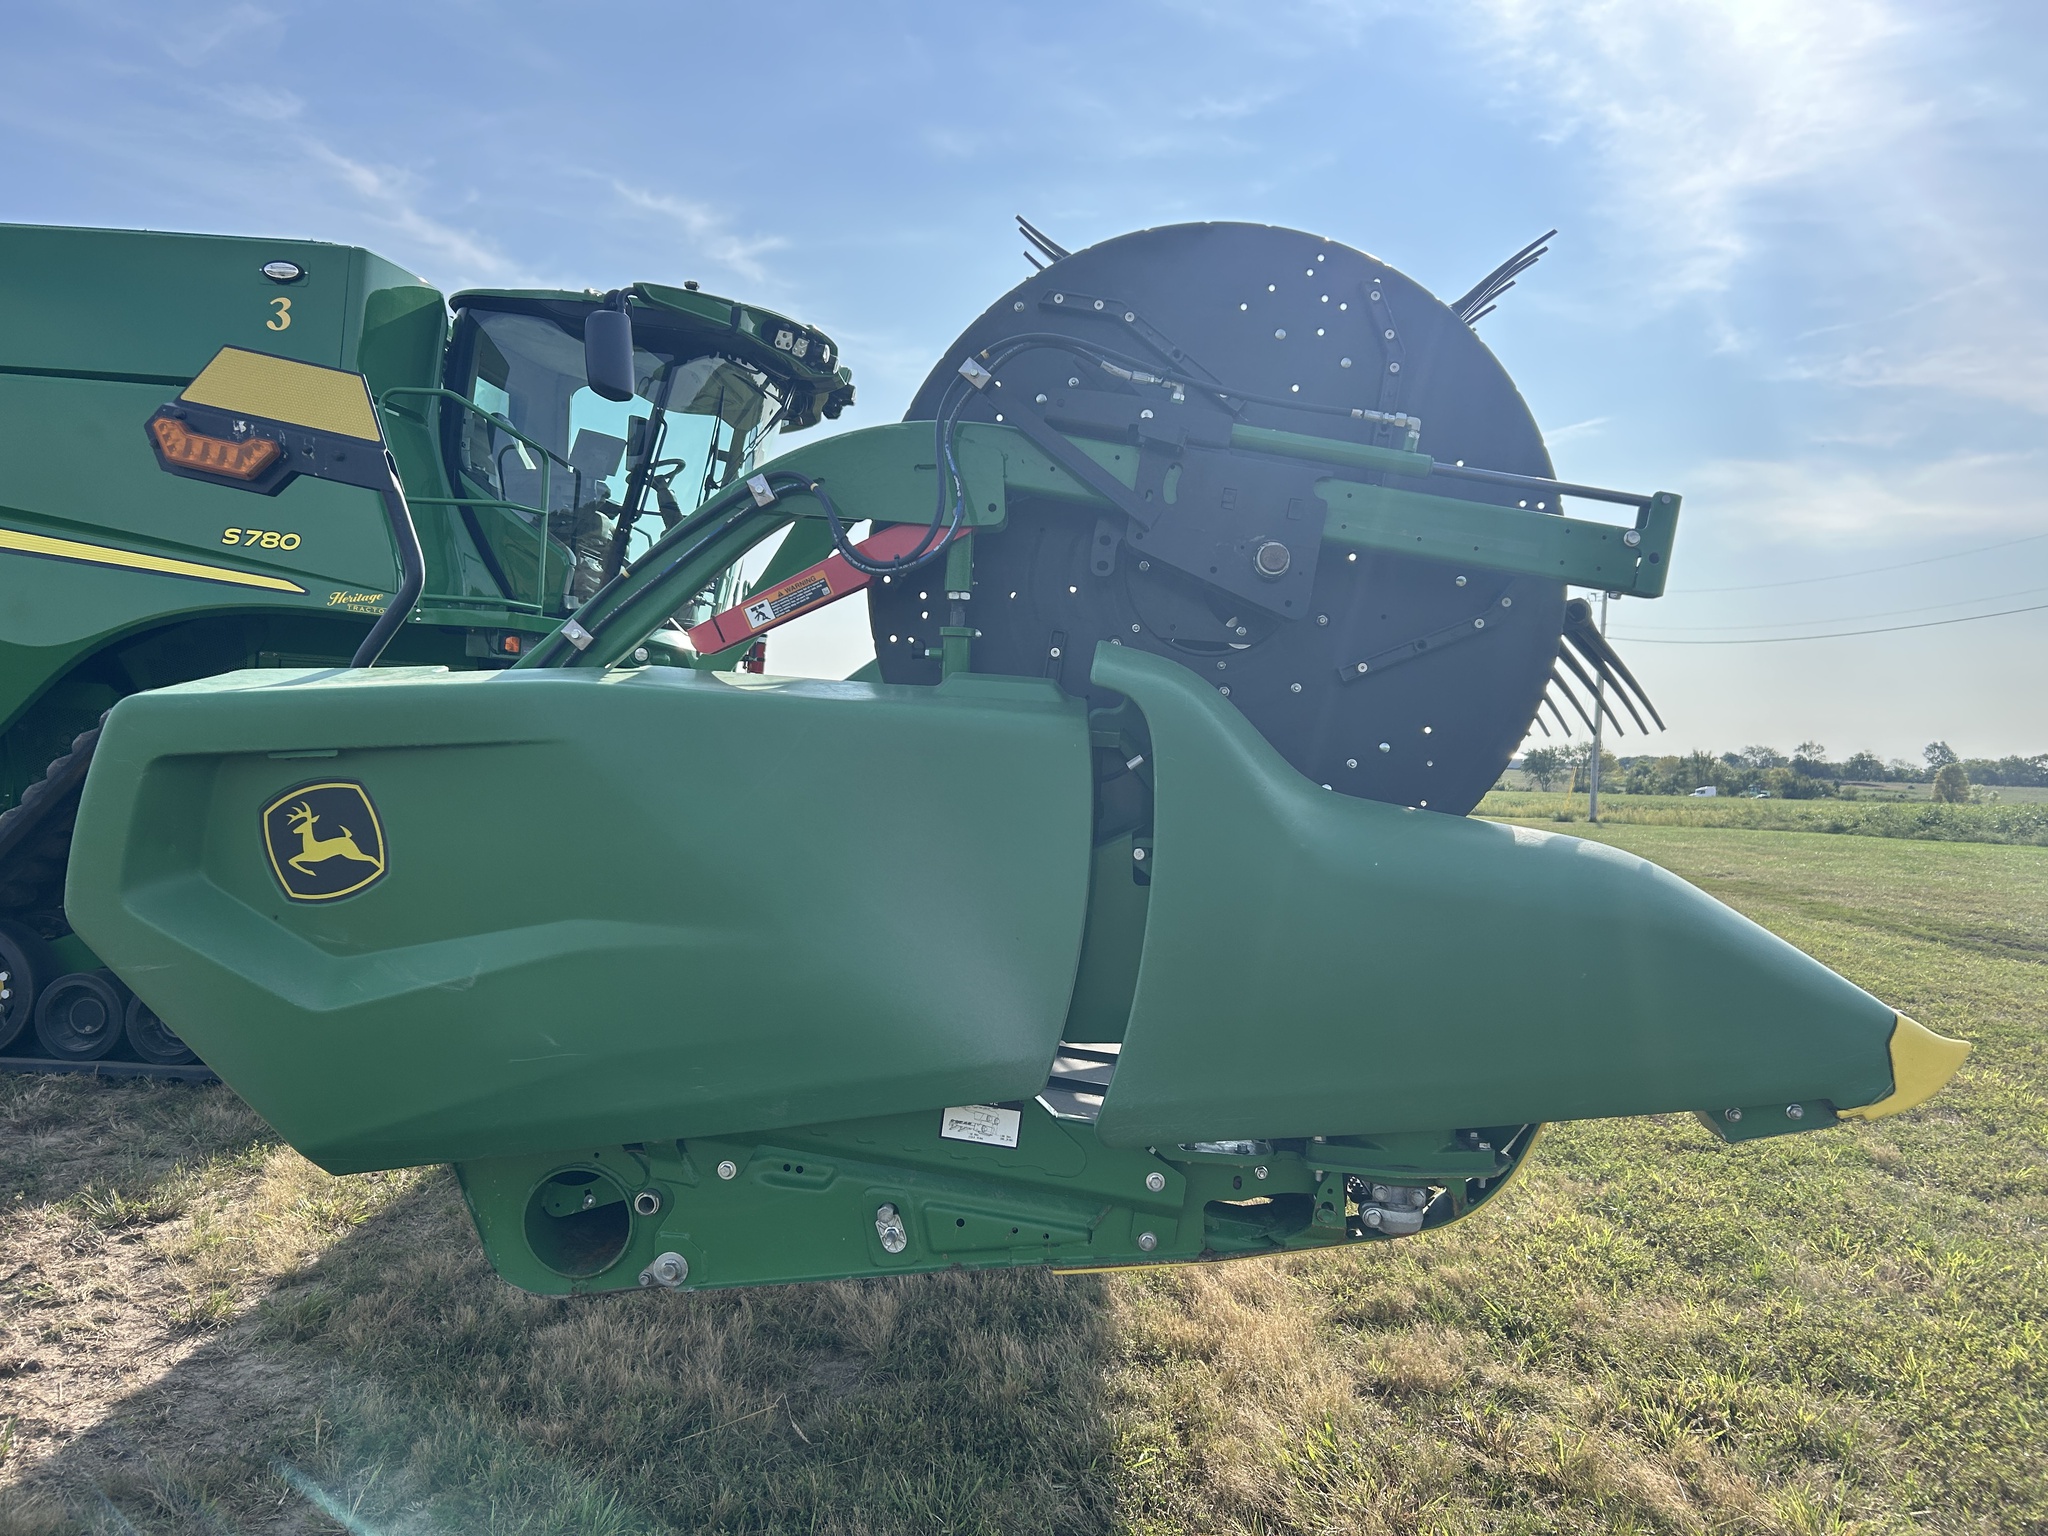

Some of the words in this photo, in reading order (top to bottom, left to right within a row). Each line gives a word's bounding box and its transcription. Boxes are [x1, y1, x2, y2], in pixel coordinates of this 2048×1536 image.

[266, 297, 292, 331] 3
[221, 527, 302, 551] S780
[784, 575, 816, 594] WARNING
[327, 590, 384, 607] Heritage
[347, 604, 386, 614] TRACTO
